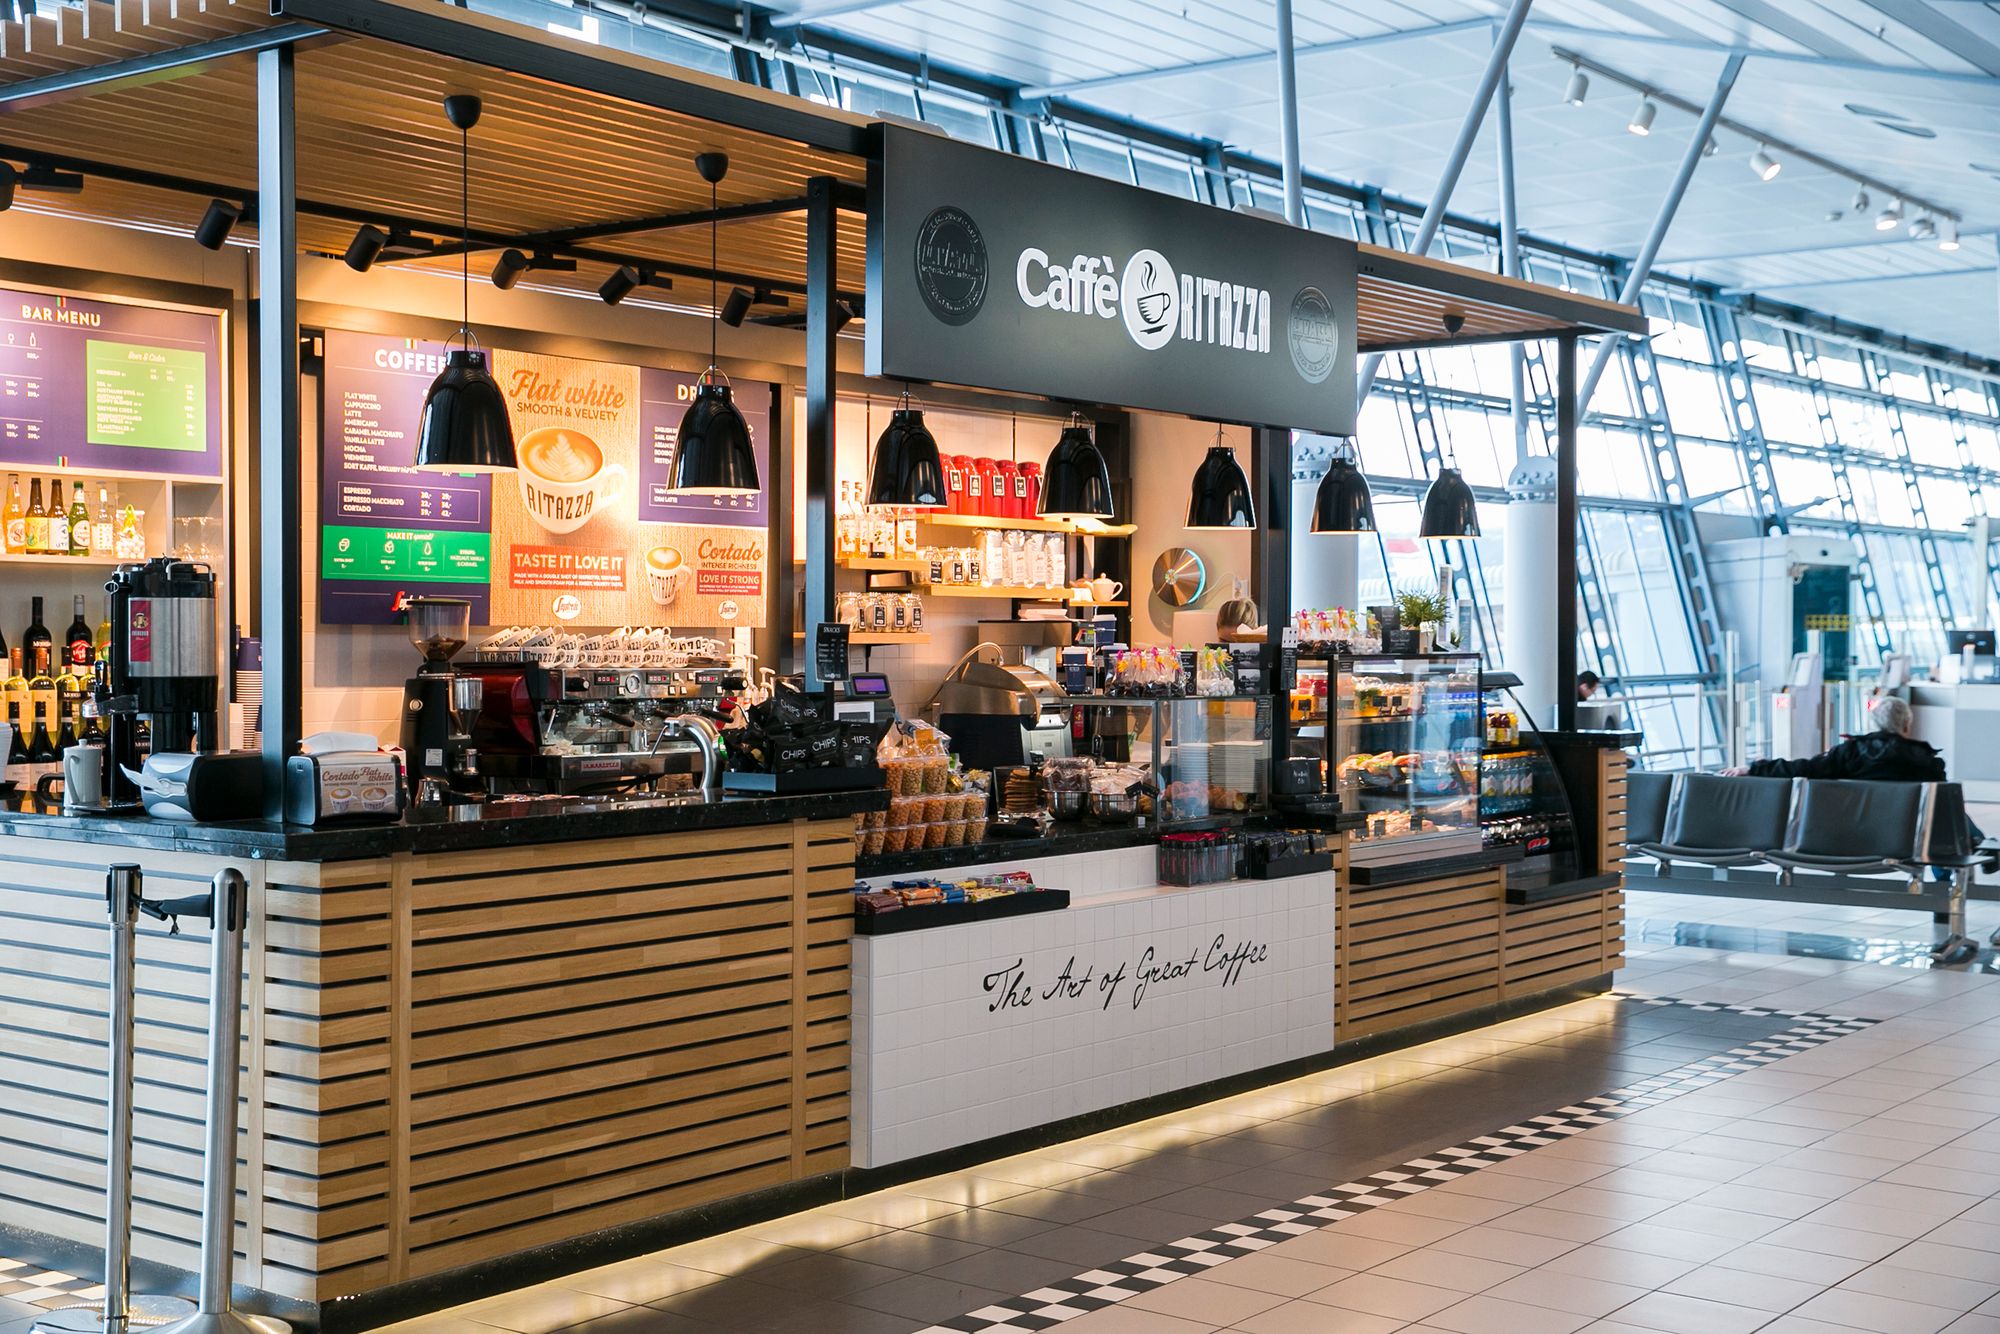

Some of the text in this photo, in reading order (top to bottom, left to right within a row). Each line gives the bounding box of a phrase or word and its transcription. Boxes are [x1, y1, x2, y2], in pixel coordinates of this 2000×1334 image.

[1016, 247, 1119, 319] Caffè
[1180, 273, 1271, 353] RITAZZA
[22, 304, 101, 327] BAR MENU
[375, 349, 446, 374] COFFEE
[509, 369, 625, 409] Flat white
[344, 401, 382, 411] CAPPUCCINO
[517, 402, 619, 421] SMOOTH & VELVETY
[344, 419, 378, 428] AMERICANO
[371, 430, 404, 439] MACCHIATO
[368, 438, 385, 446] LATTE
[344, 445, 366, 453] MOCHA
[344, 462, 359, 470] SORT
[344, 487, 372, 495] ESPRESSO
[344, 496, 405, 506] ESPRESSO MACCHIATO
[526, 482, 594, 520] RITAZZA
[386, 532, 406, 540] MAKE
[698, 539, 763, 561] Cortado
[514, 553, 624, 570] TASTE IT LOVE IT
[700, 574, 760, 585] LOVE IT STRONG
[781, 699, 800, 718] CHIPS
[812, 737, 837, 752] CHIPS
[781, 749, 806, 760] CHIPS
[322, 770, 360, 782] Cortado
[360, 766, 379, 777] Flat
[983, 934, 1268, 1012] The Art of Great Coffee
